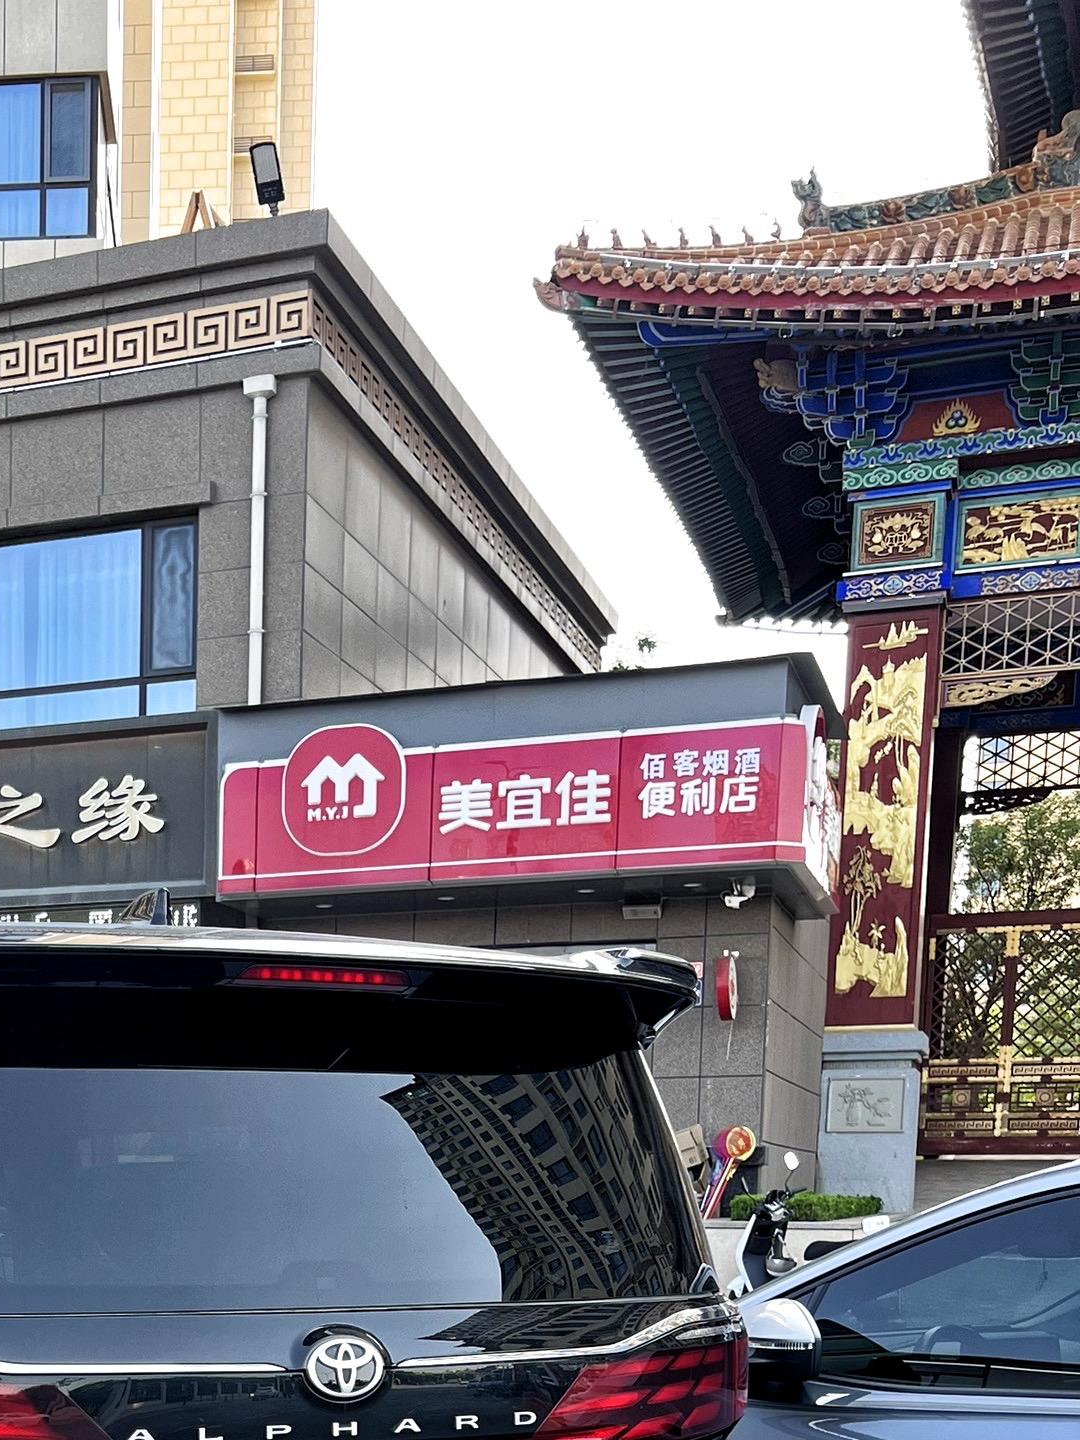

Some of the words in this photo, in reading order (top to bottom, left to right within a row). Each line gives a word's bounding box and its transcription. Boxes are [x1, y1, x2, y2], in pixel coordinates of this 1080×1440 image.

[639, 747, 761, 781] 佰客烟酒
[307, 807, 349, 823] M.Y.J
[438, 769, 612, 836] 美宜佳
[638, 775, 760, 819] 便利店
